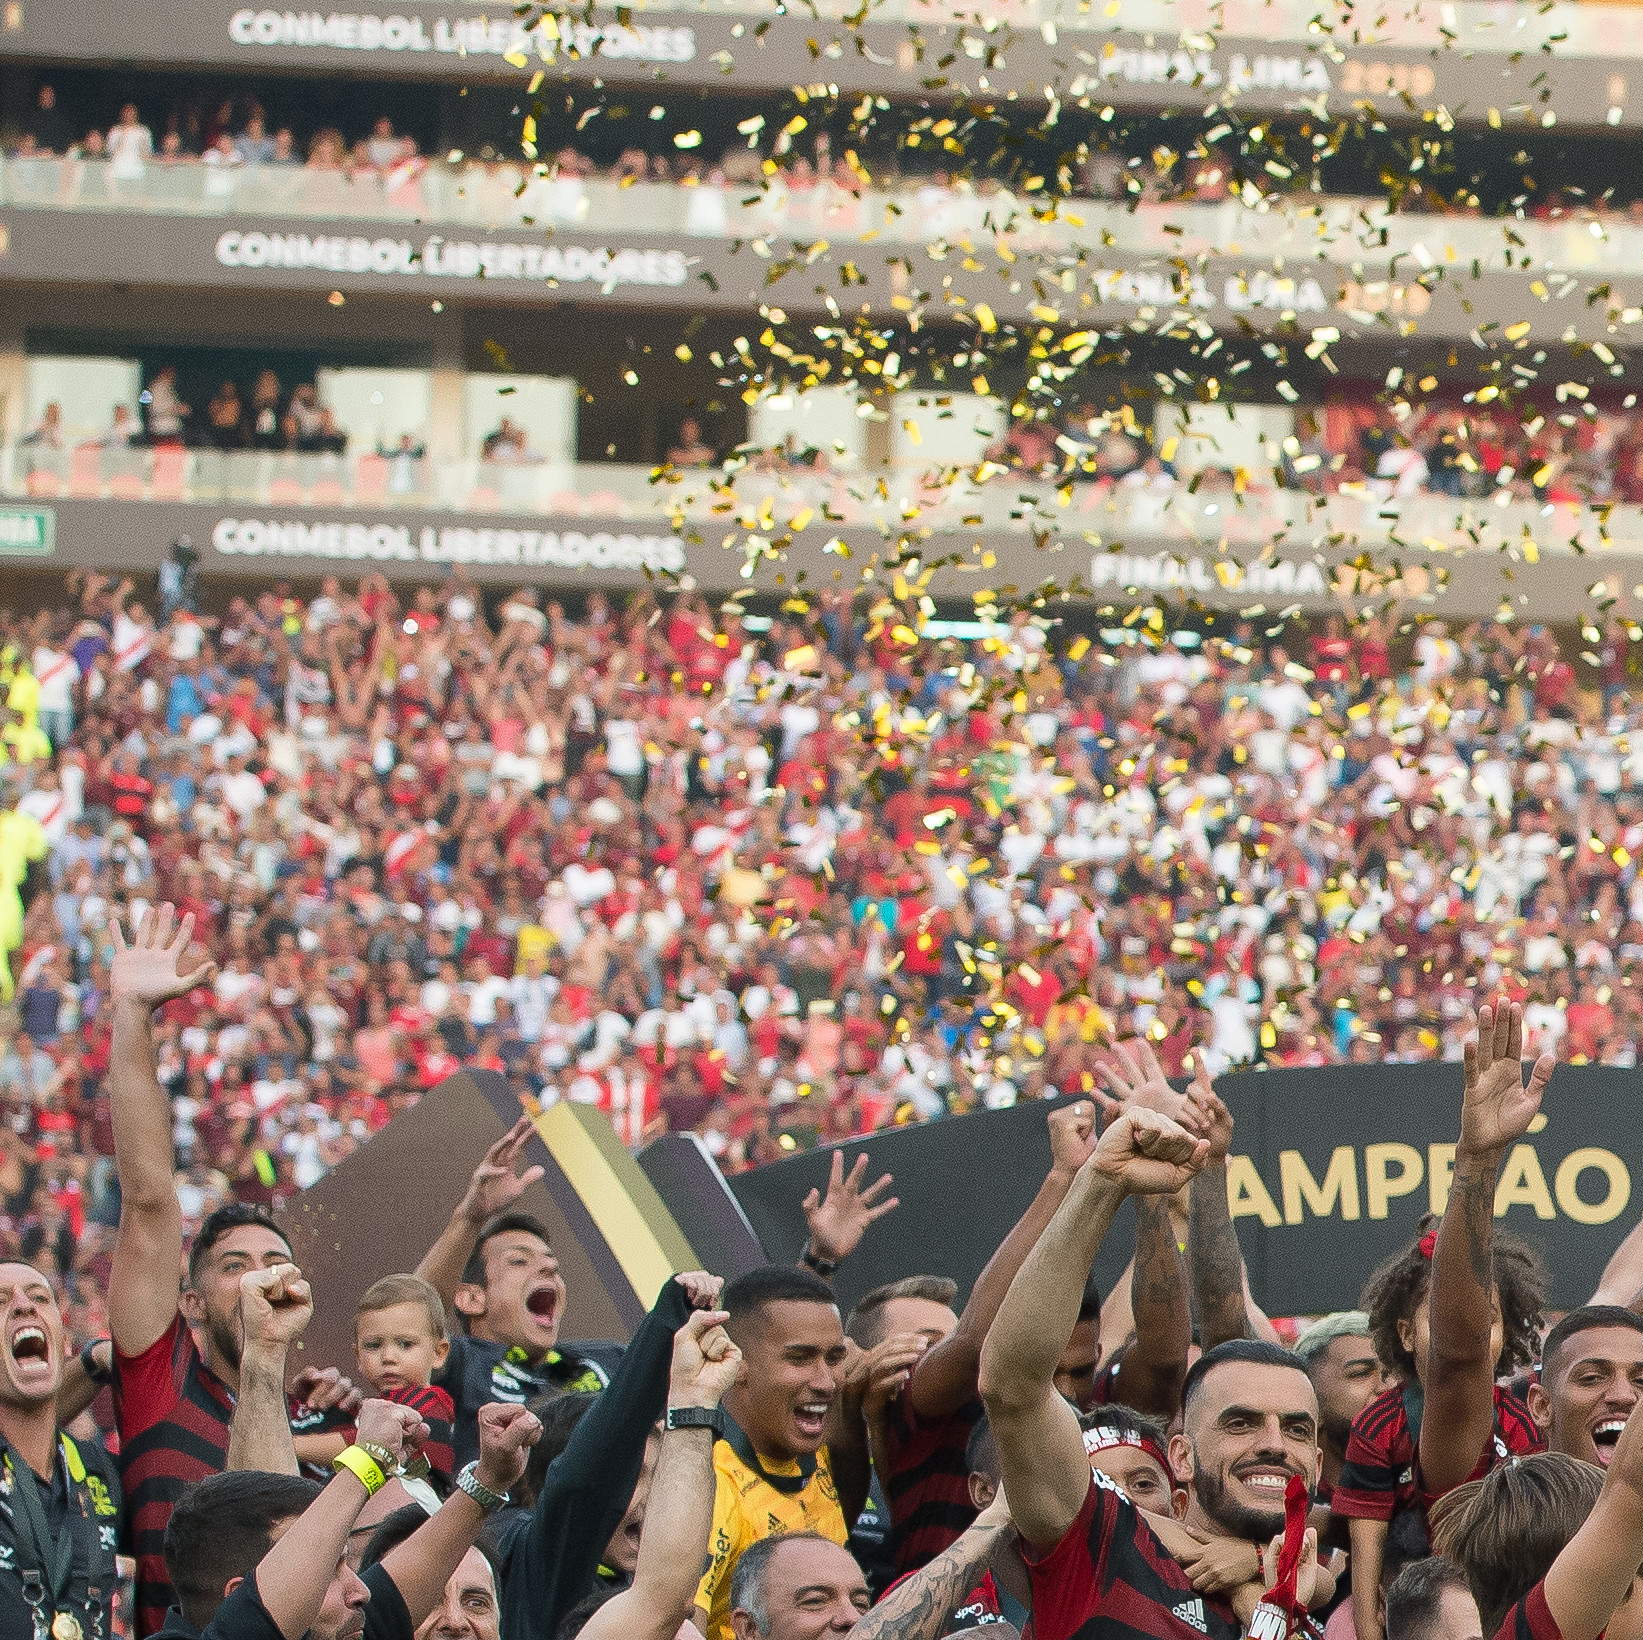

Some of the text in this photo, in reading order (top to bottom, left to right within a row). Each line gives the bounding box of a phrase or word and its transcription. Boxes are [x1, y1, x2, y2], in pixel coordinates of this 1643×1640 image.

[229, 9, 431, 52] CONMEBOL
[1228, 53, 1332, 90] LIMA
[215, 231, 687, 285] CONMEBOL LIBERTADORES
[213, 518, 685, 570] CONMEBOL LIBERTADORES
[1228, 1112, 1632, 1228] AMPEÃO
[1172, 1605, 1208, 1634] adidas
